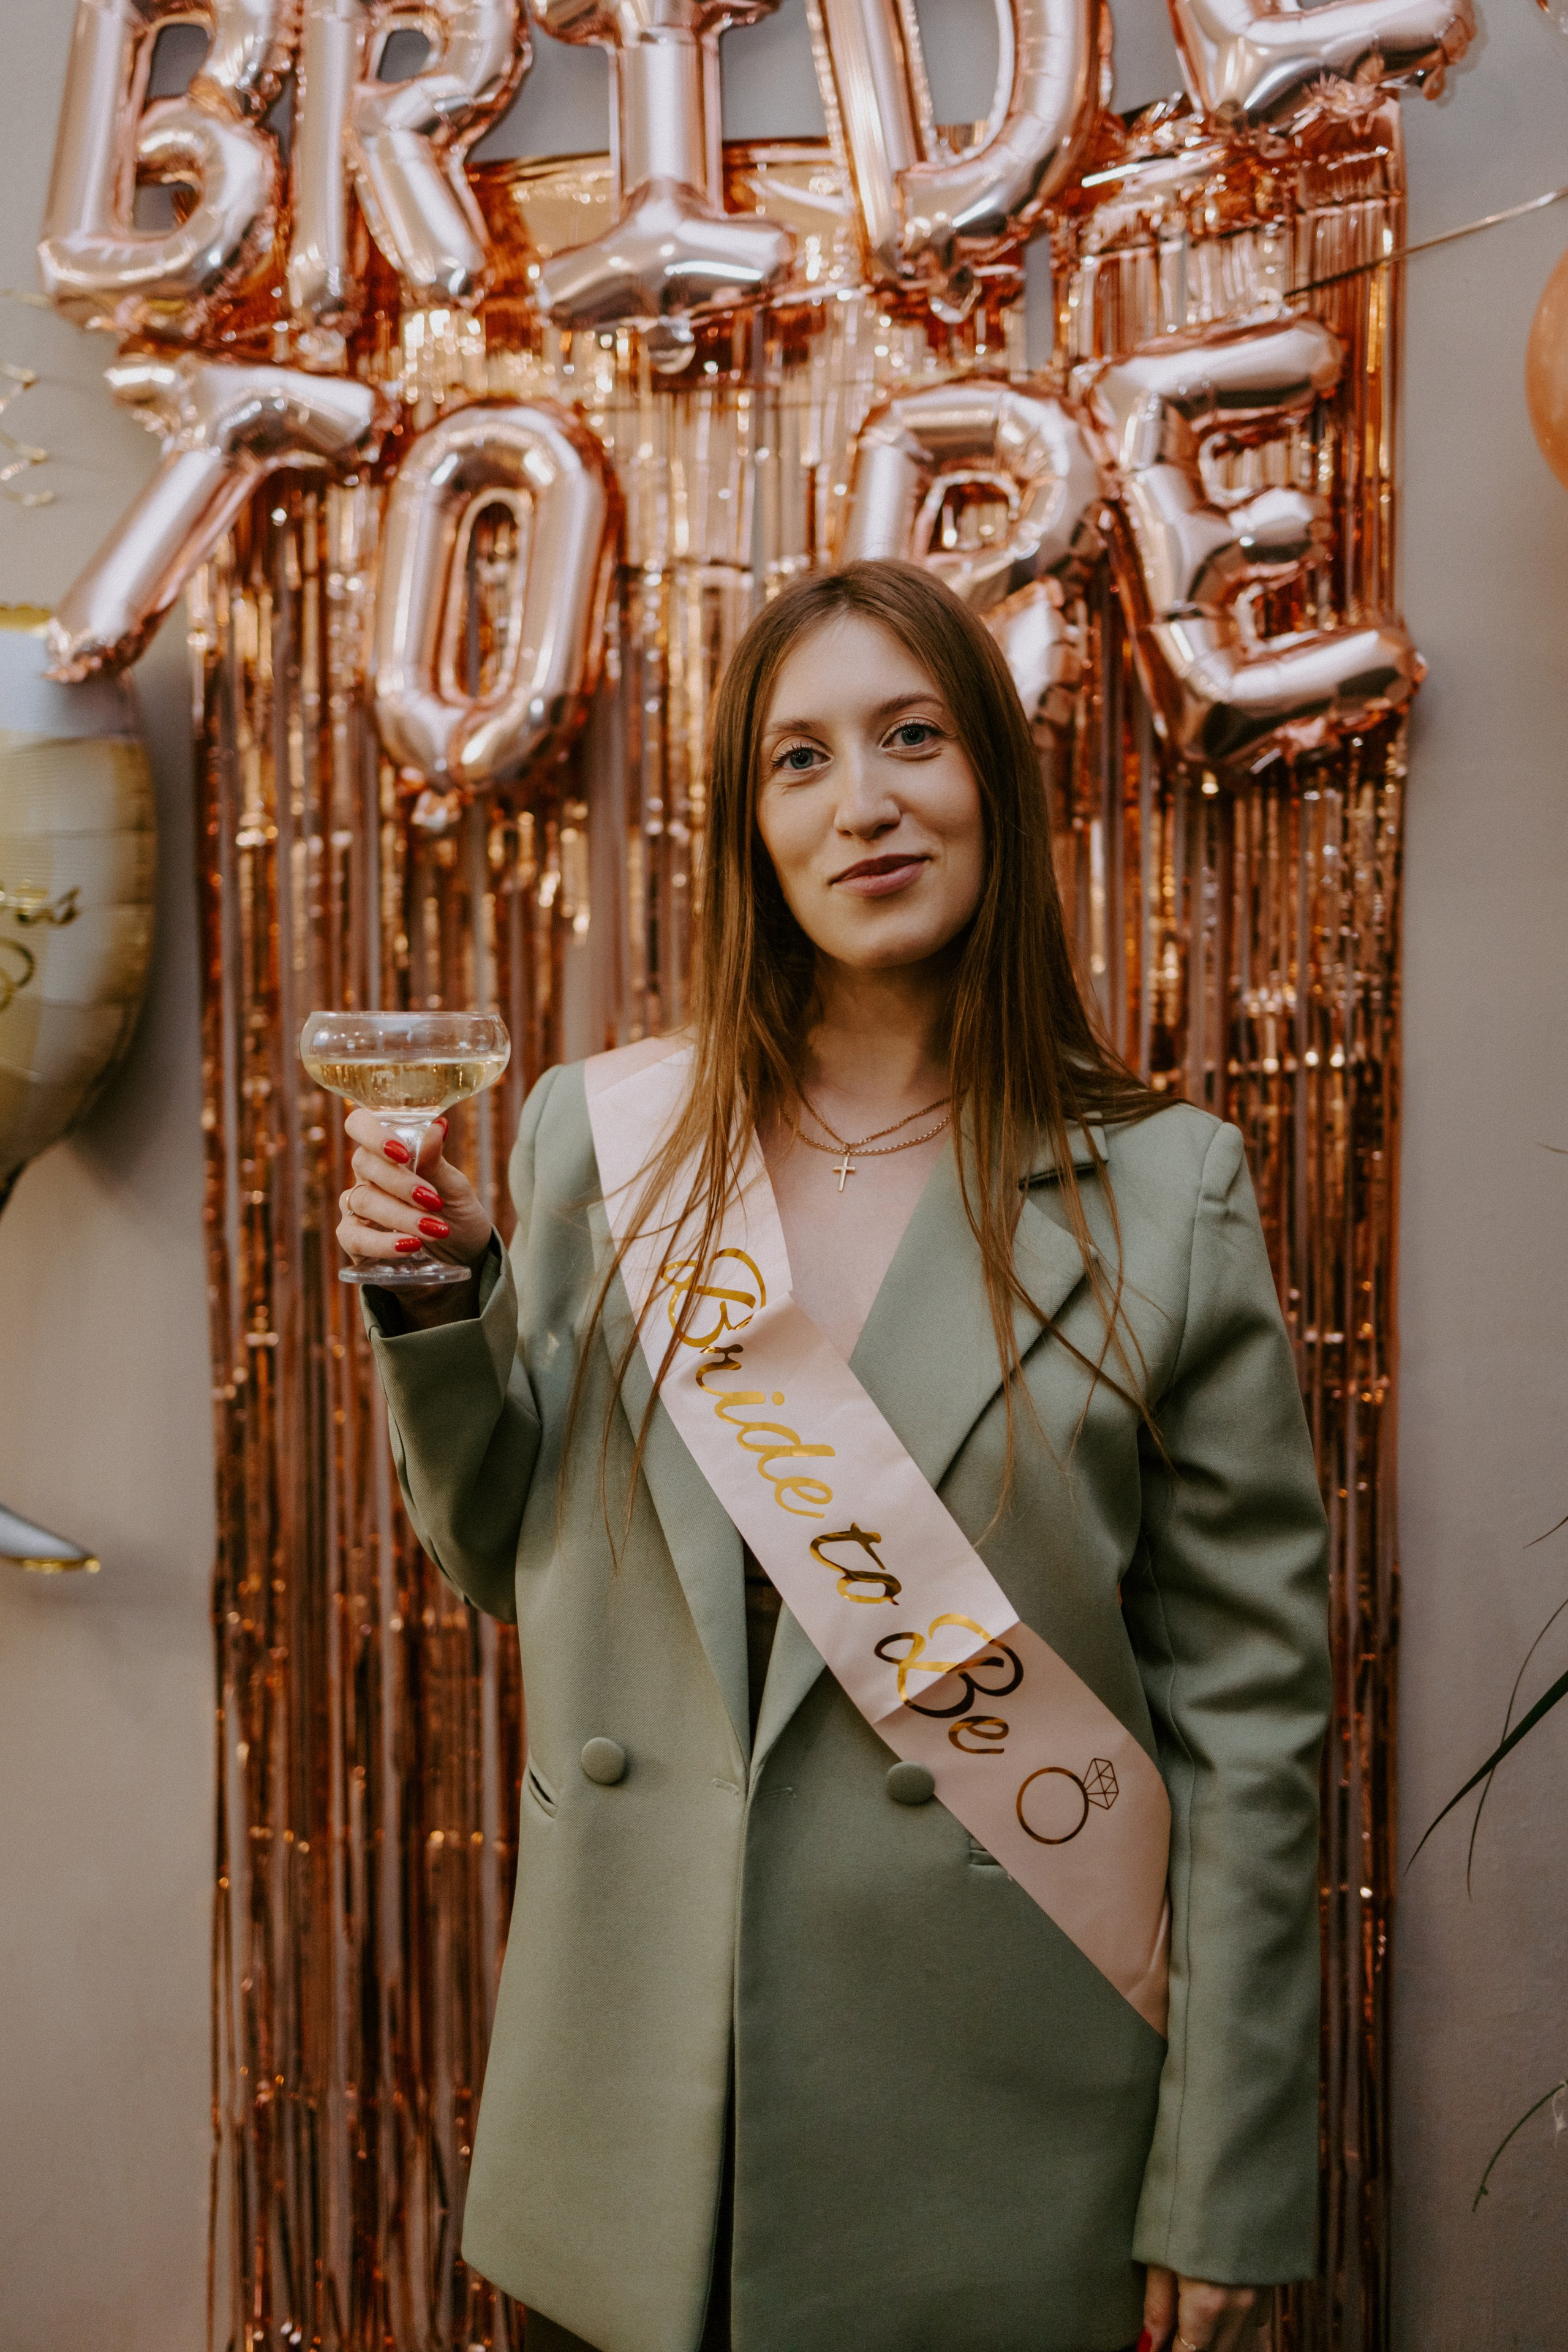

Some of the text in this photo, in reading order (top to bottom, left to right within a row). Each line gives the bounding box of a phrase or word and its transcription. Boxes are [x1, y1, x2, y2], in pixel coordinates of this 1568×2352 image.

[43, 349, 616, 802] TO
[660, 1247, 1024, 1754] Bride to Be
